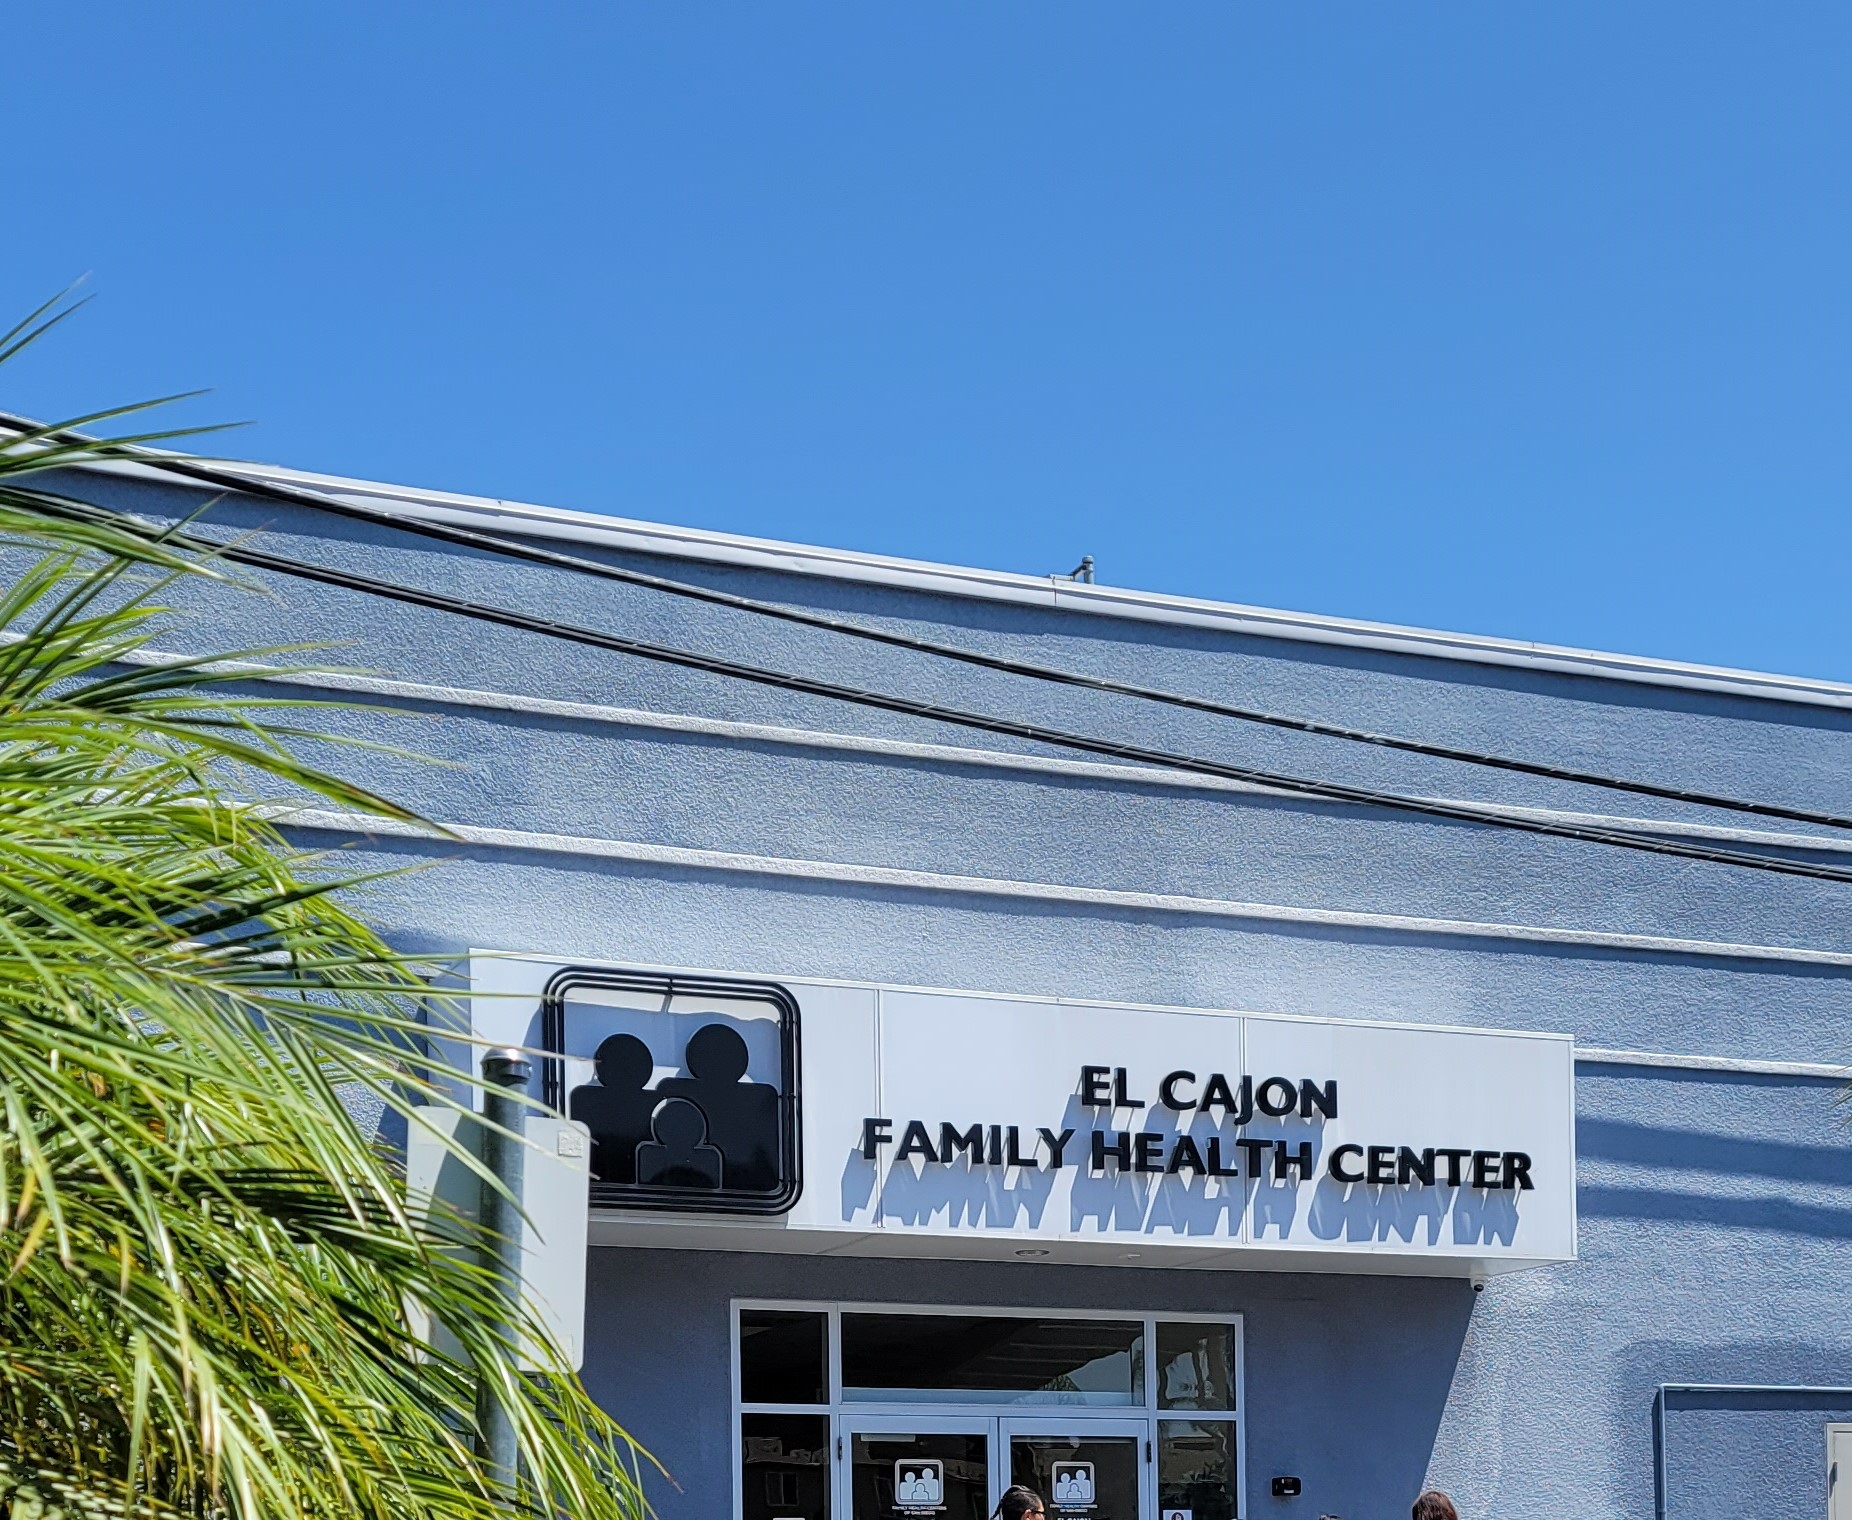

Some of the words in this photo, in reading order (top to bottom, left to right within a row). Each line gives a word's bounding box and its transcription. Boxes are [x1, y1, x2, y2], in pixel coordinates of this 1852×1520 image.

[1081, 1065, 1145, 1108] EL
[1159, 1070, 1338, 1126] CAJON
[863, 1117, 1076, 1169] FAMILY
[1091, 1130, 1313, 1181] HEALTH
[1328, 1143, 1535, 1190] CENTER
